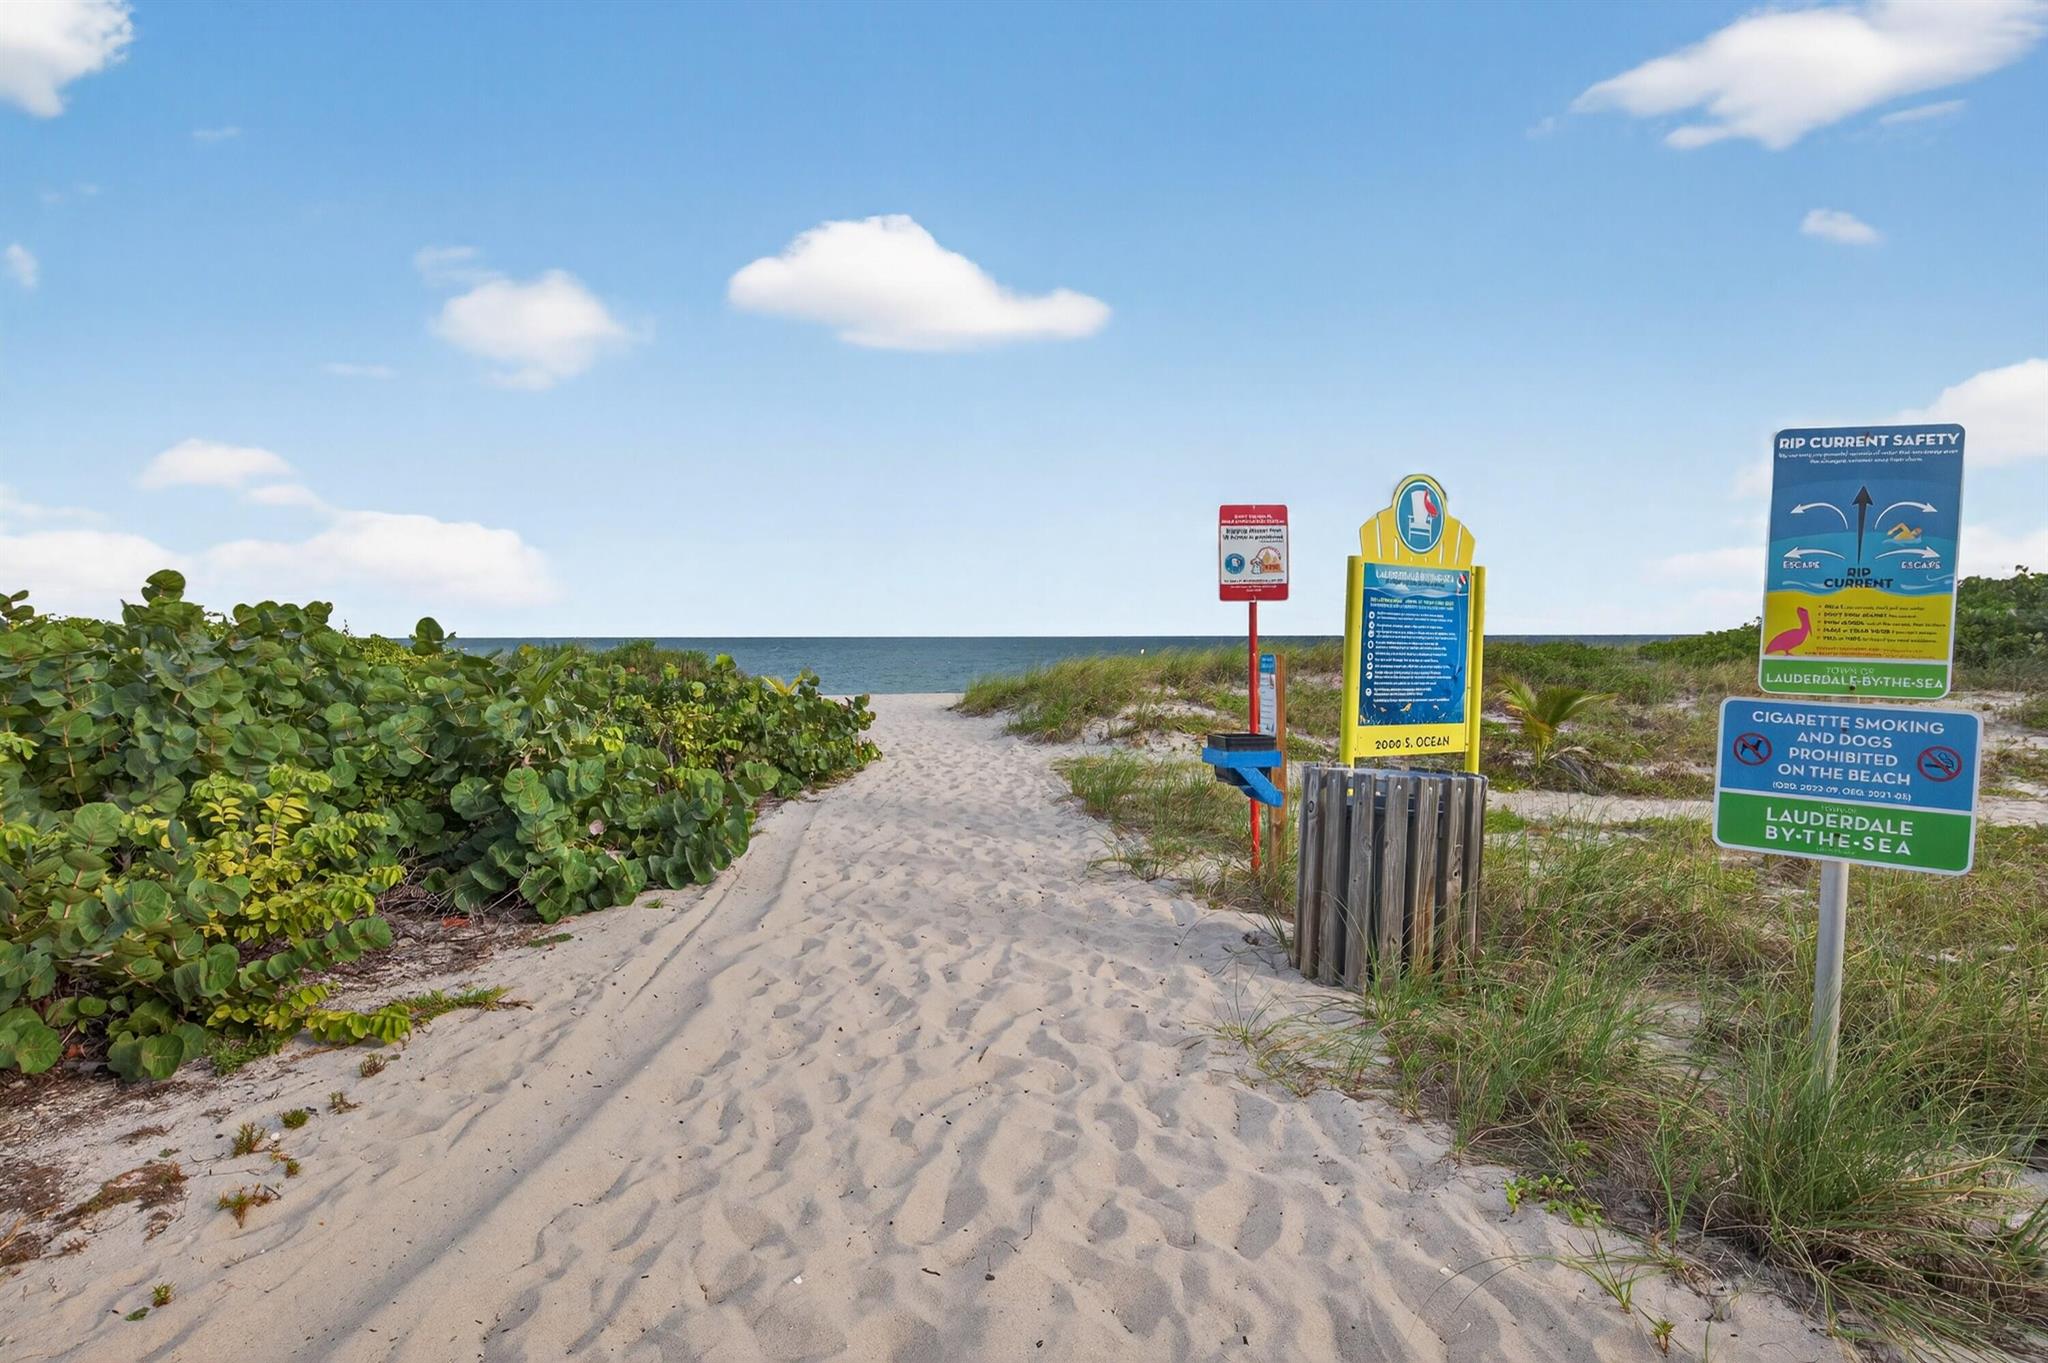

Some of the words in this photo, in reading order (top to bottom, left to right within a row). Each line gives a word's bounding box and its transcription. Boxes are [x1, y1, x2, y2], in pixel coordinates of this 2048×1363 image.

[1779, 438, 1805, 449] RIP
[1809, 434, 1889, 449] CURRENT
[1892, 432, 1960, 446] SAFETY
[1846, 567, 1871, 578] RIP
[1823, 577, 1894, 589] CURRENT
[1752, 710, 1851, 729] CIGARETTE
[1854, 716, 1945, 735] SMOKING
[1375, 739, 1402, 750] 2000
[1404, 737, 1413, 749] S.
[1415, 735, 1450, 747] OCEAN
[1797, 732, 1835, 745] AND
[1839, 734, 1893, 749] DOGS
[1788, 747, 1898, 767] PROHIBITED
[1777, 763, 1804, 778] ON
[1808, 765, 1843, 780] THE
[1847, 769, 1911, 786] BEACH
[1766, 806, 1913, 836] LAUDERDALE
